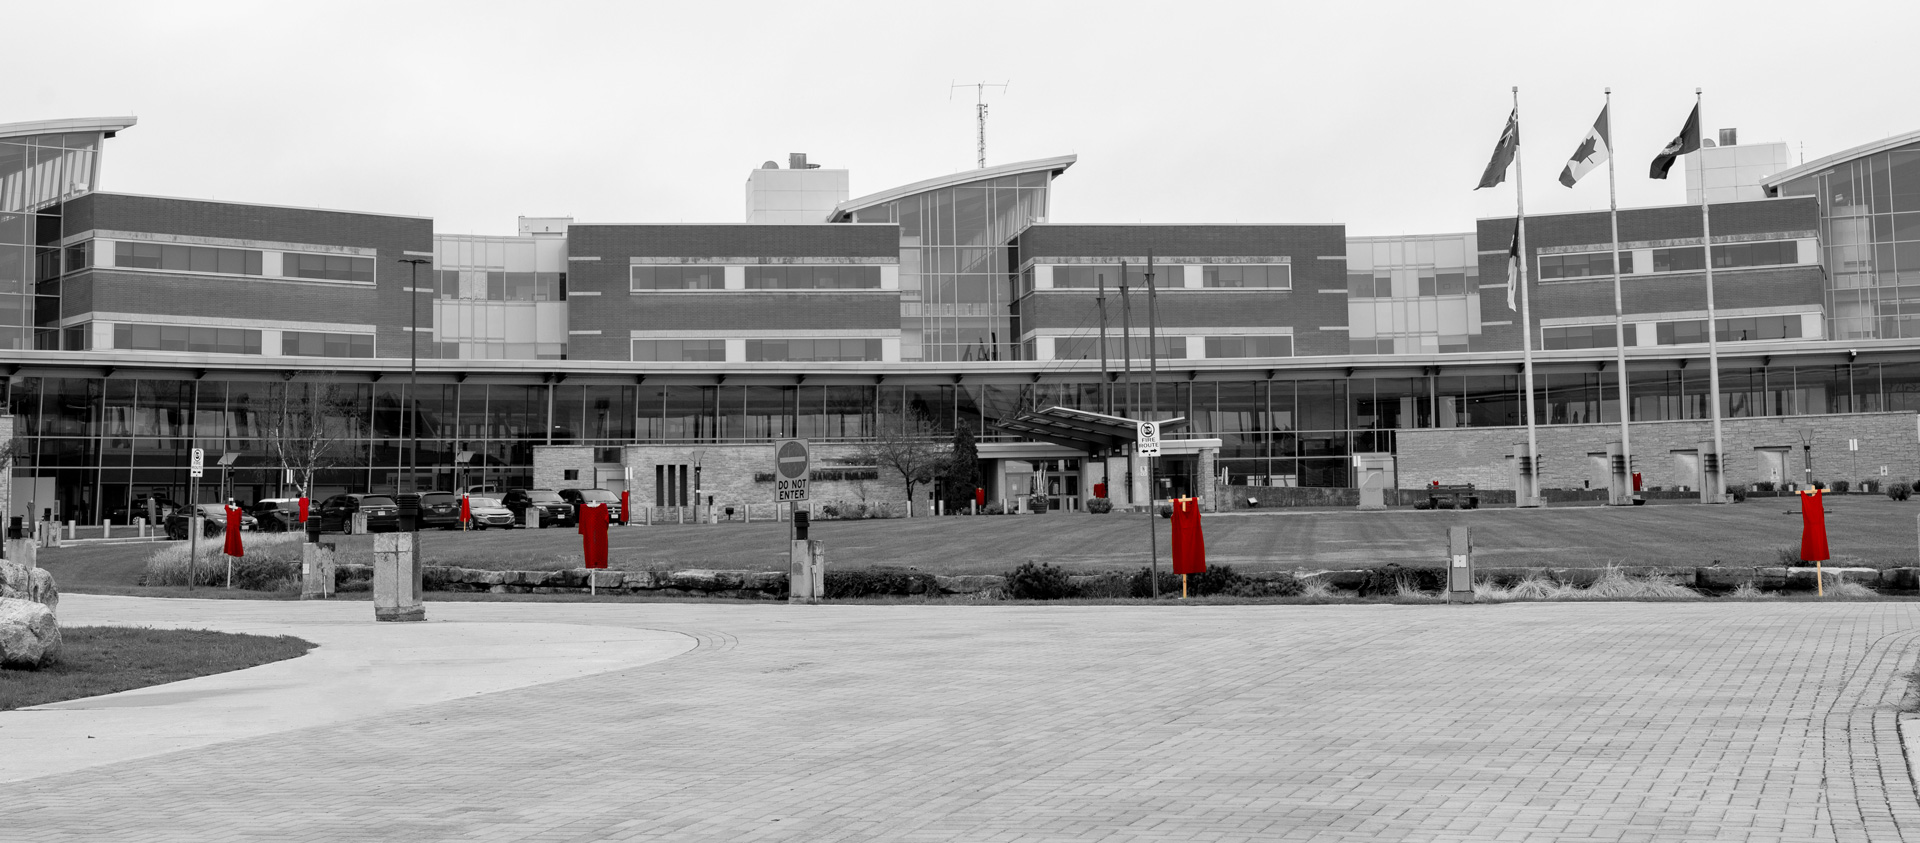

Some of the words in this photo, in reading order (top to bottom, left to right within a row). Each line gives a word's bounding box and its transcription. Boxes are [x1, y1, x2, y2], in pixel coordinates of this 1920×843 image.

[809, 472, 842, 481] EXANDER
[844, 471, 878, 481] BUILDING
[778, 480, 788, 490] DO
[792, 479, 806, 489] NOT
[780, 490, 804, 500] ENTER
